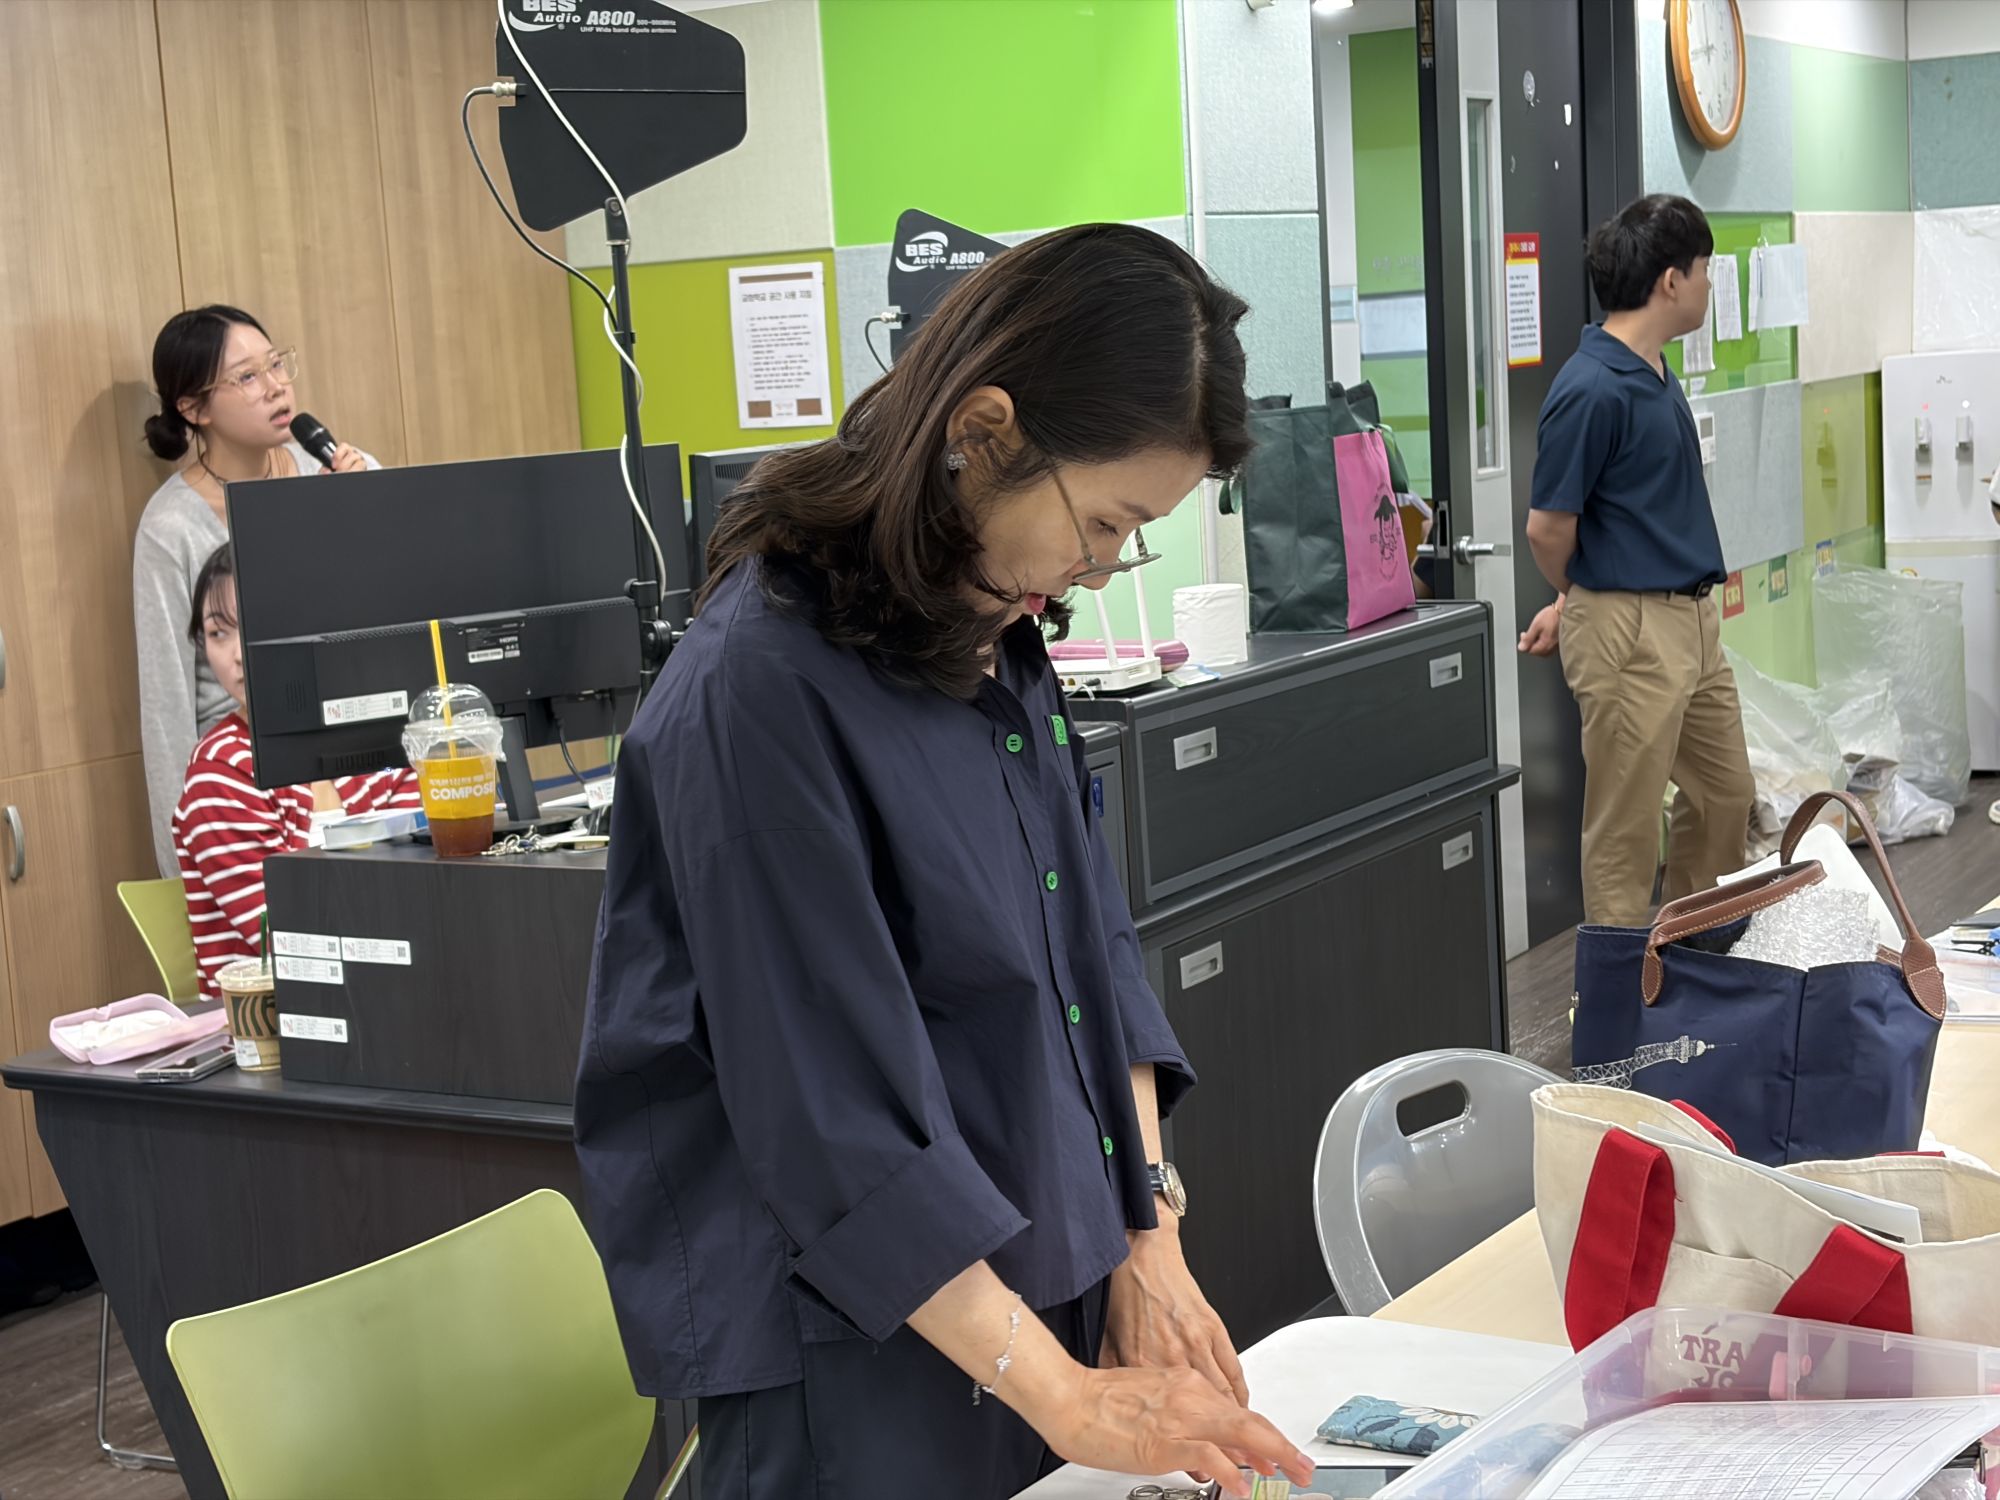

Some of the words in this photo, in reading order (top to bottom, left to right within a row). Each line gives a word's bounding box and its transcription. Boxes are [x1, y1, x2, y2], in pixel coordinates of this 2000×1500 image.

[523, 0, 577, 12] BES
[533, 12, 582, 23] Audio
[586, 11, 636, 25] A800
[905, 243, 944, 257] BES
[913, 256, 947, 265] Audio
[949, 251, 985, 265] A800
